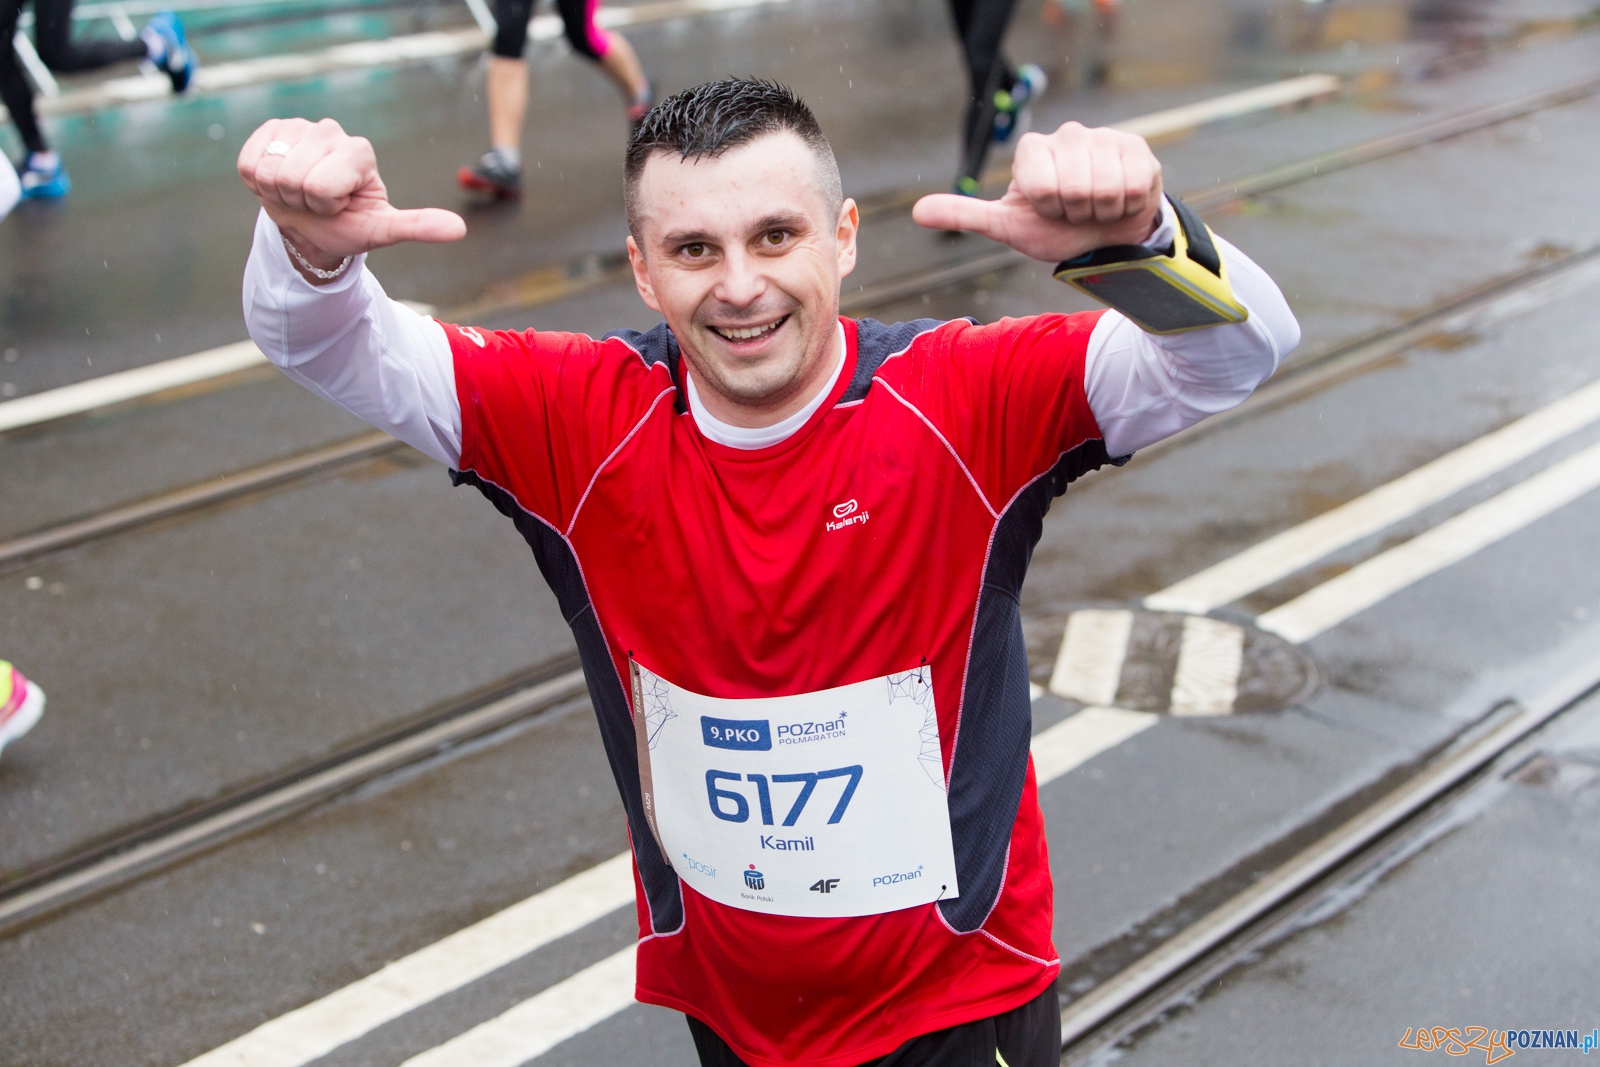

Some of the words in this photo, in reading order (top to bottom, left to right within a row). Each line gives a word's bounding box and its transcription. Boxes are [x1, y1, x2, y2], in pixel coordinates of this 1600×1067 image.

[825, 511, 870, 532] Kalenji
[633, 676, 642, 714] 17.04.2016
[778, 730, 846, 745] PÓŁMARATON
[705, 765, 864, 827] 6177
[760, 835, 815, 851] Kamil
[809, 878, 841, 893] 4F
[740, 892, 755, 900] Bank
